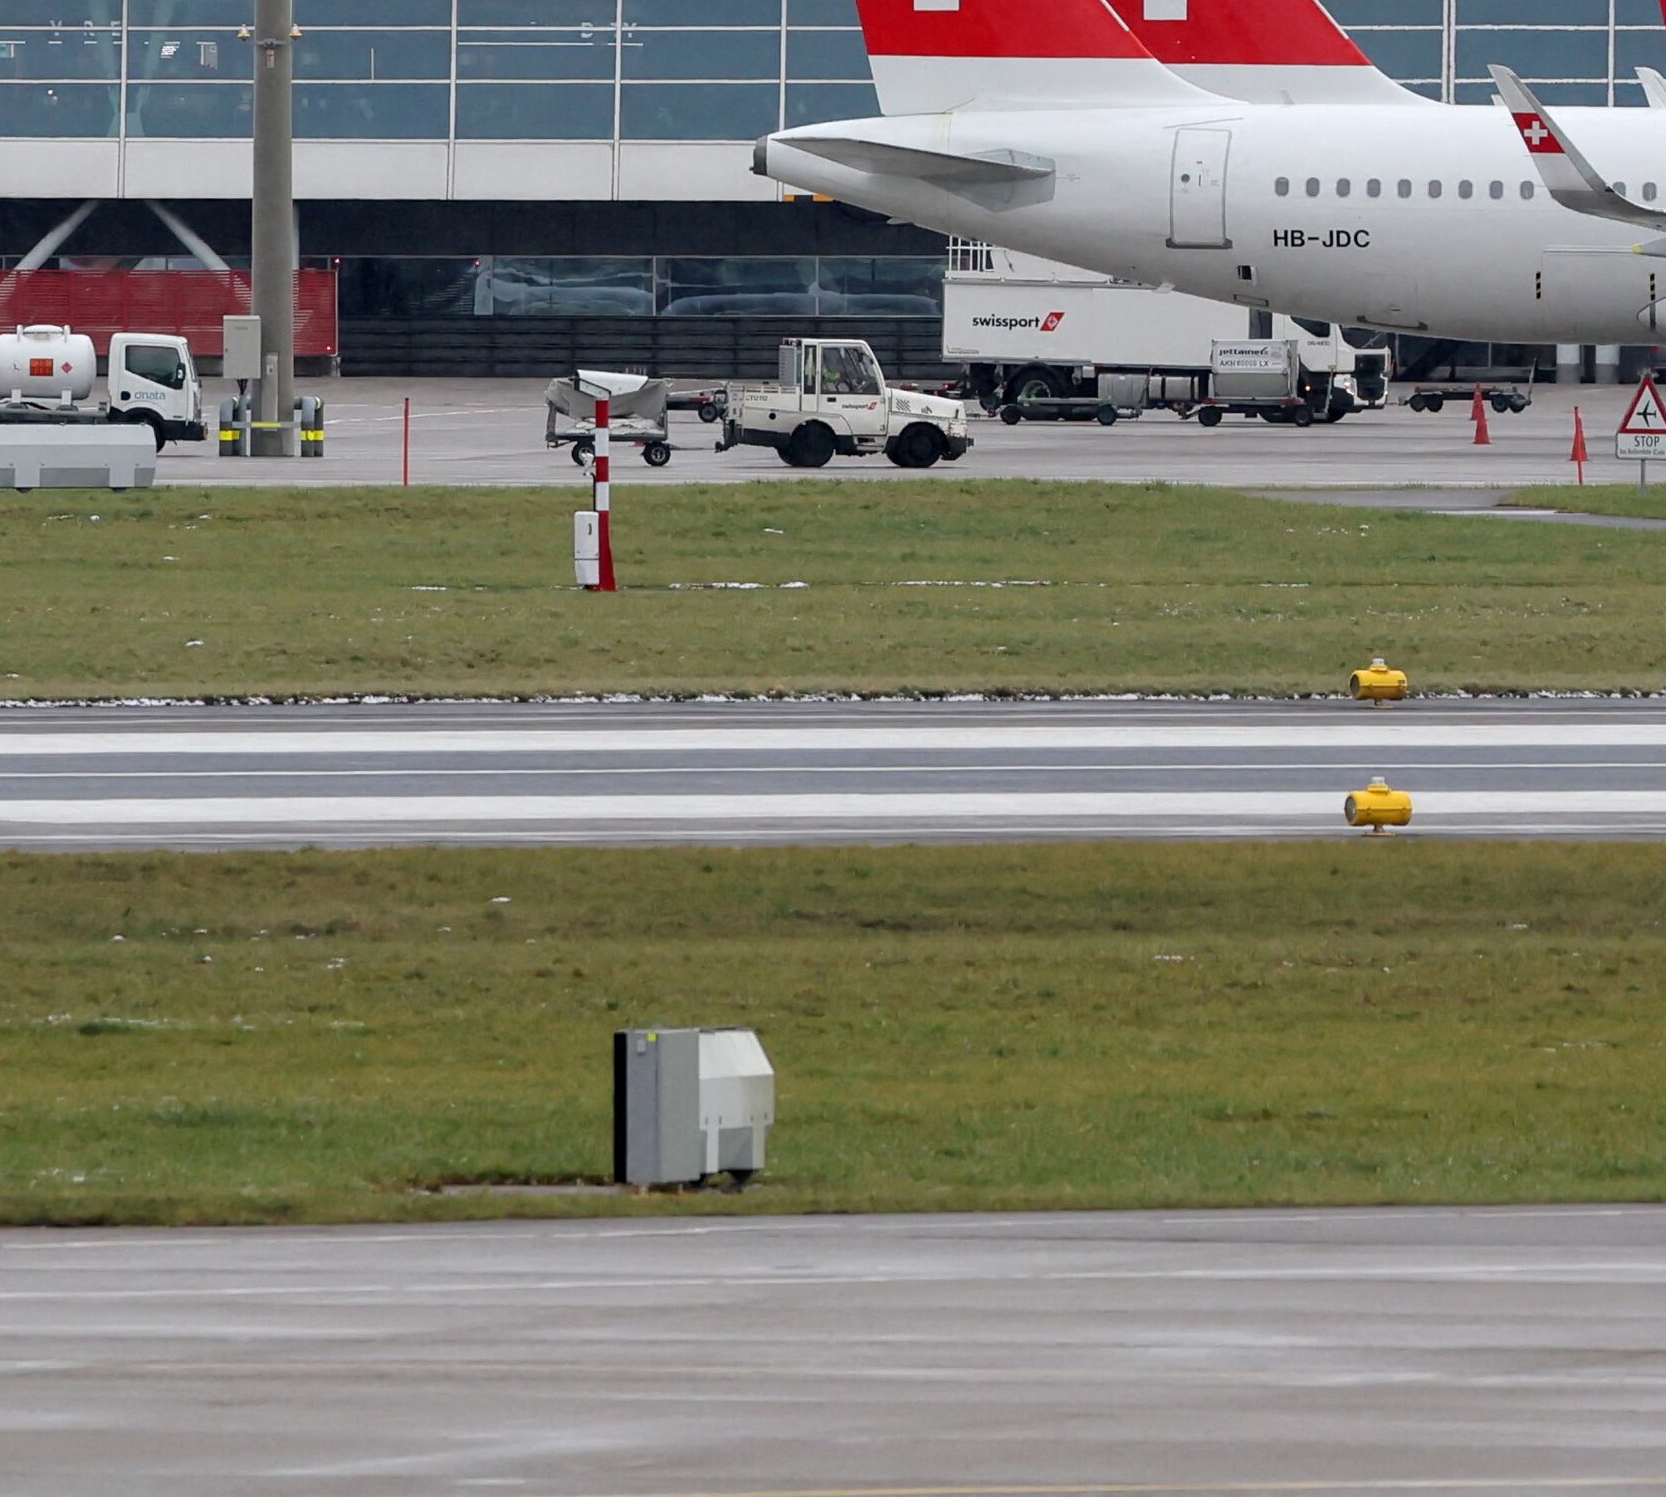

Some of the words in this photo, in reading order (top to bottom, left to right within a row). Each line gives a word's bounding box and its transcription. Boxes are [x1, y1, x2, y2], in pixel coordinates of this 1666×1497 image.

[1273, 229, 1370, 248] HB-JDC
[972, 313, 1040, 330] swissport
[134, 390, 166, 400] dnata
[1634, 435, 1660, 447] STOP
